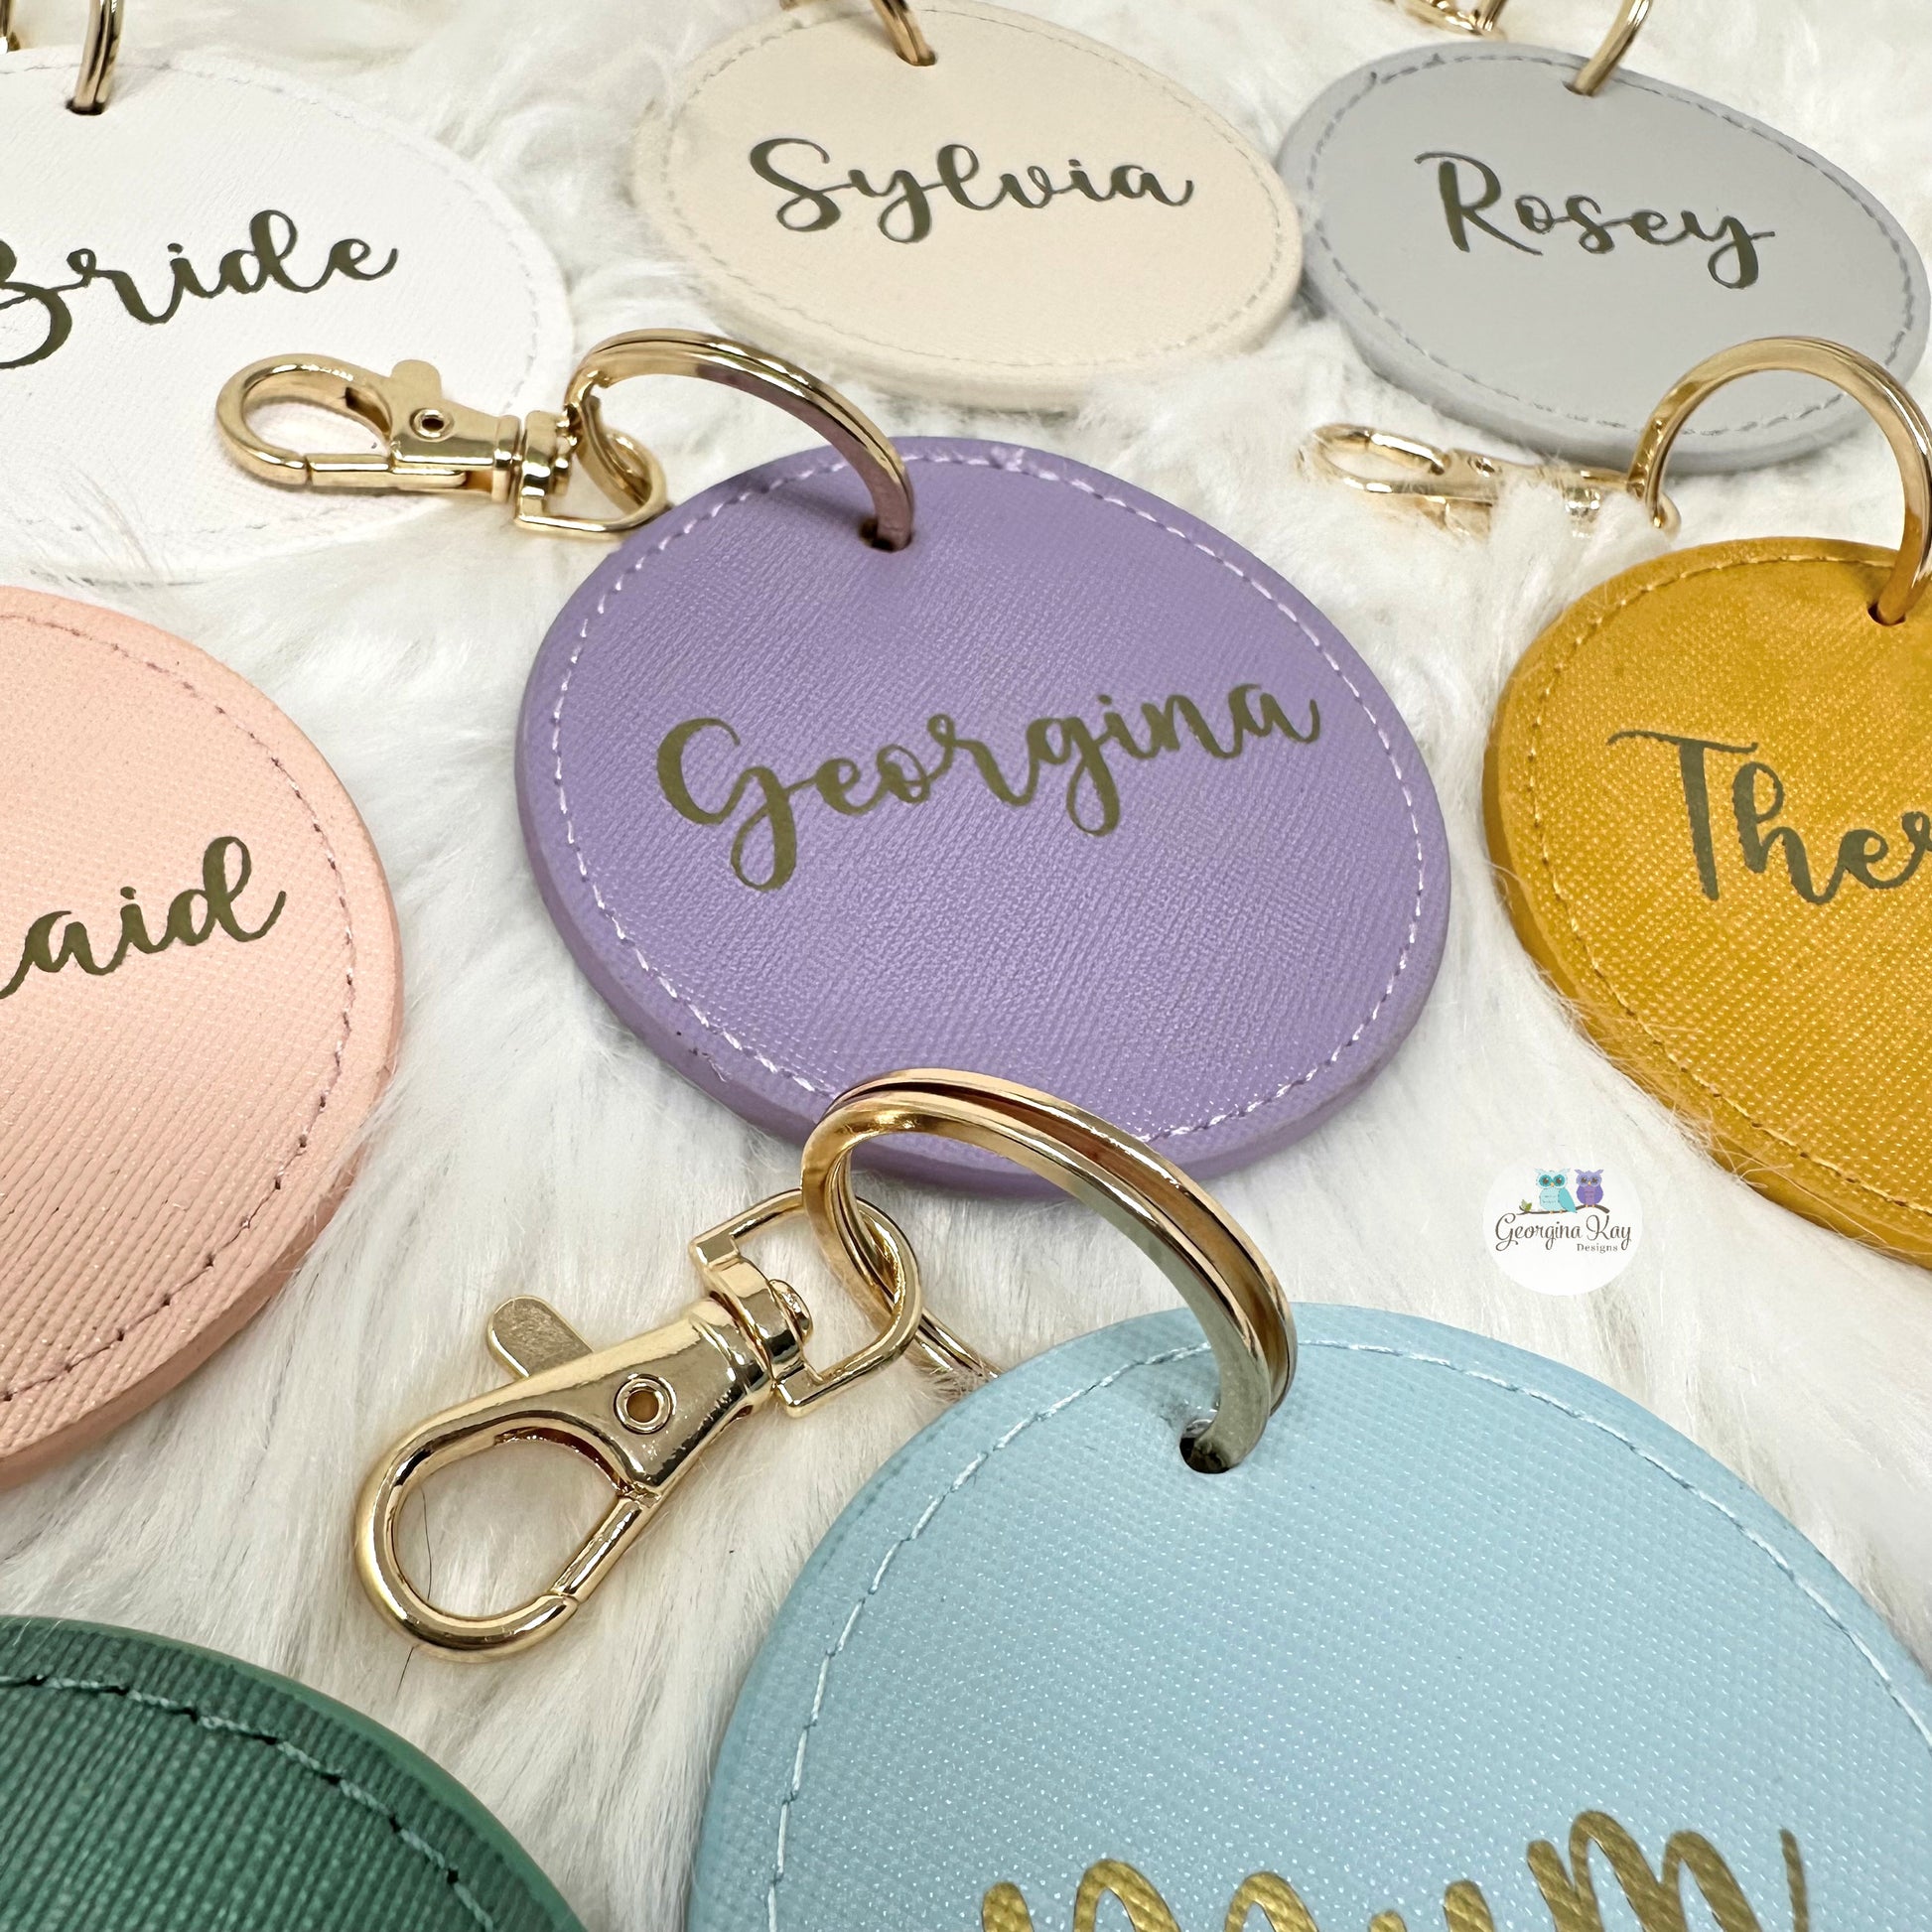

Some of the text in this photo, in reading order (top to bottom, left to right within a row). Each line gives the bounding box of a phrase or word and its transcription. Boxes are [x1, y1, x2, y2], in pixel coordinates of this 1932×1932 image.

[749, 137, 1194, 243] Sylvia
[1414, 151, 1775, 290] Rosey
[656, 683, 1320, 891] Georgina
